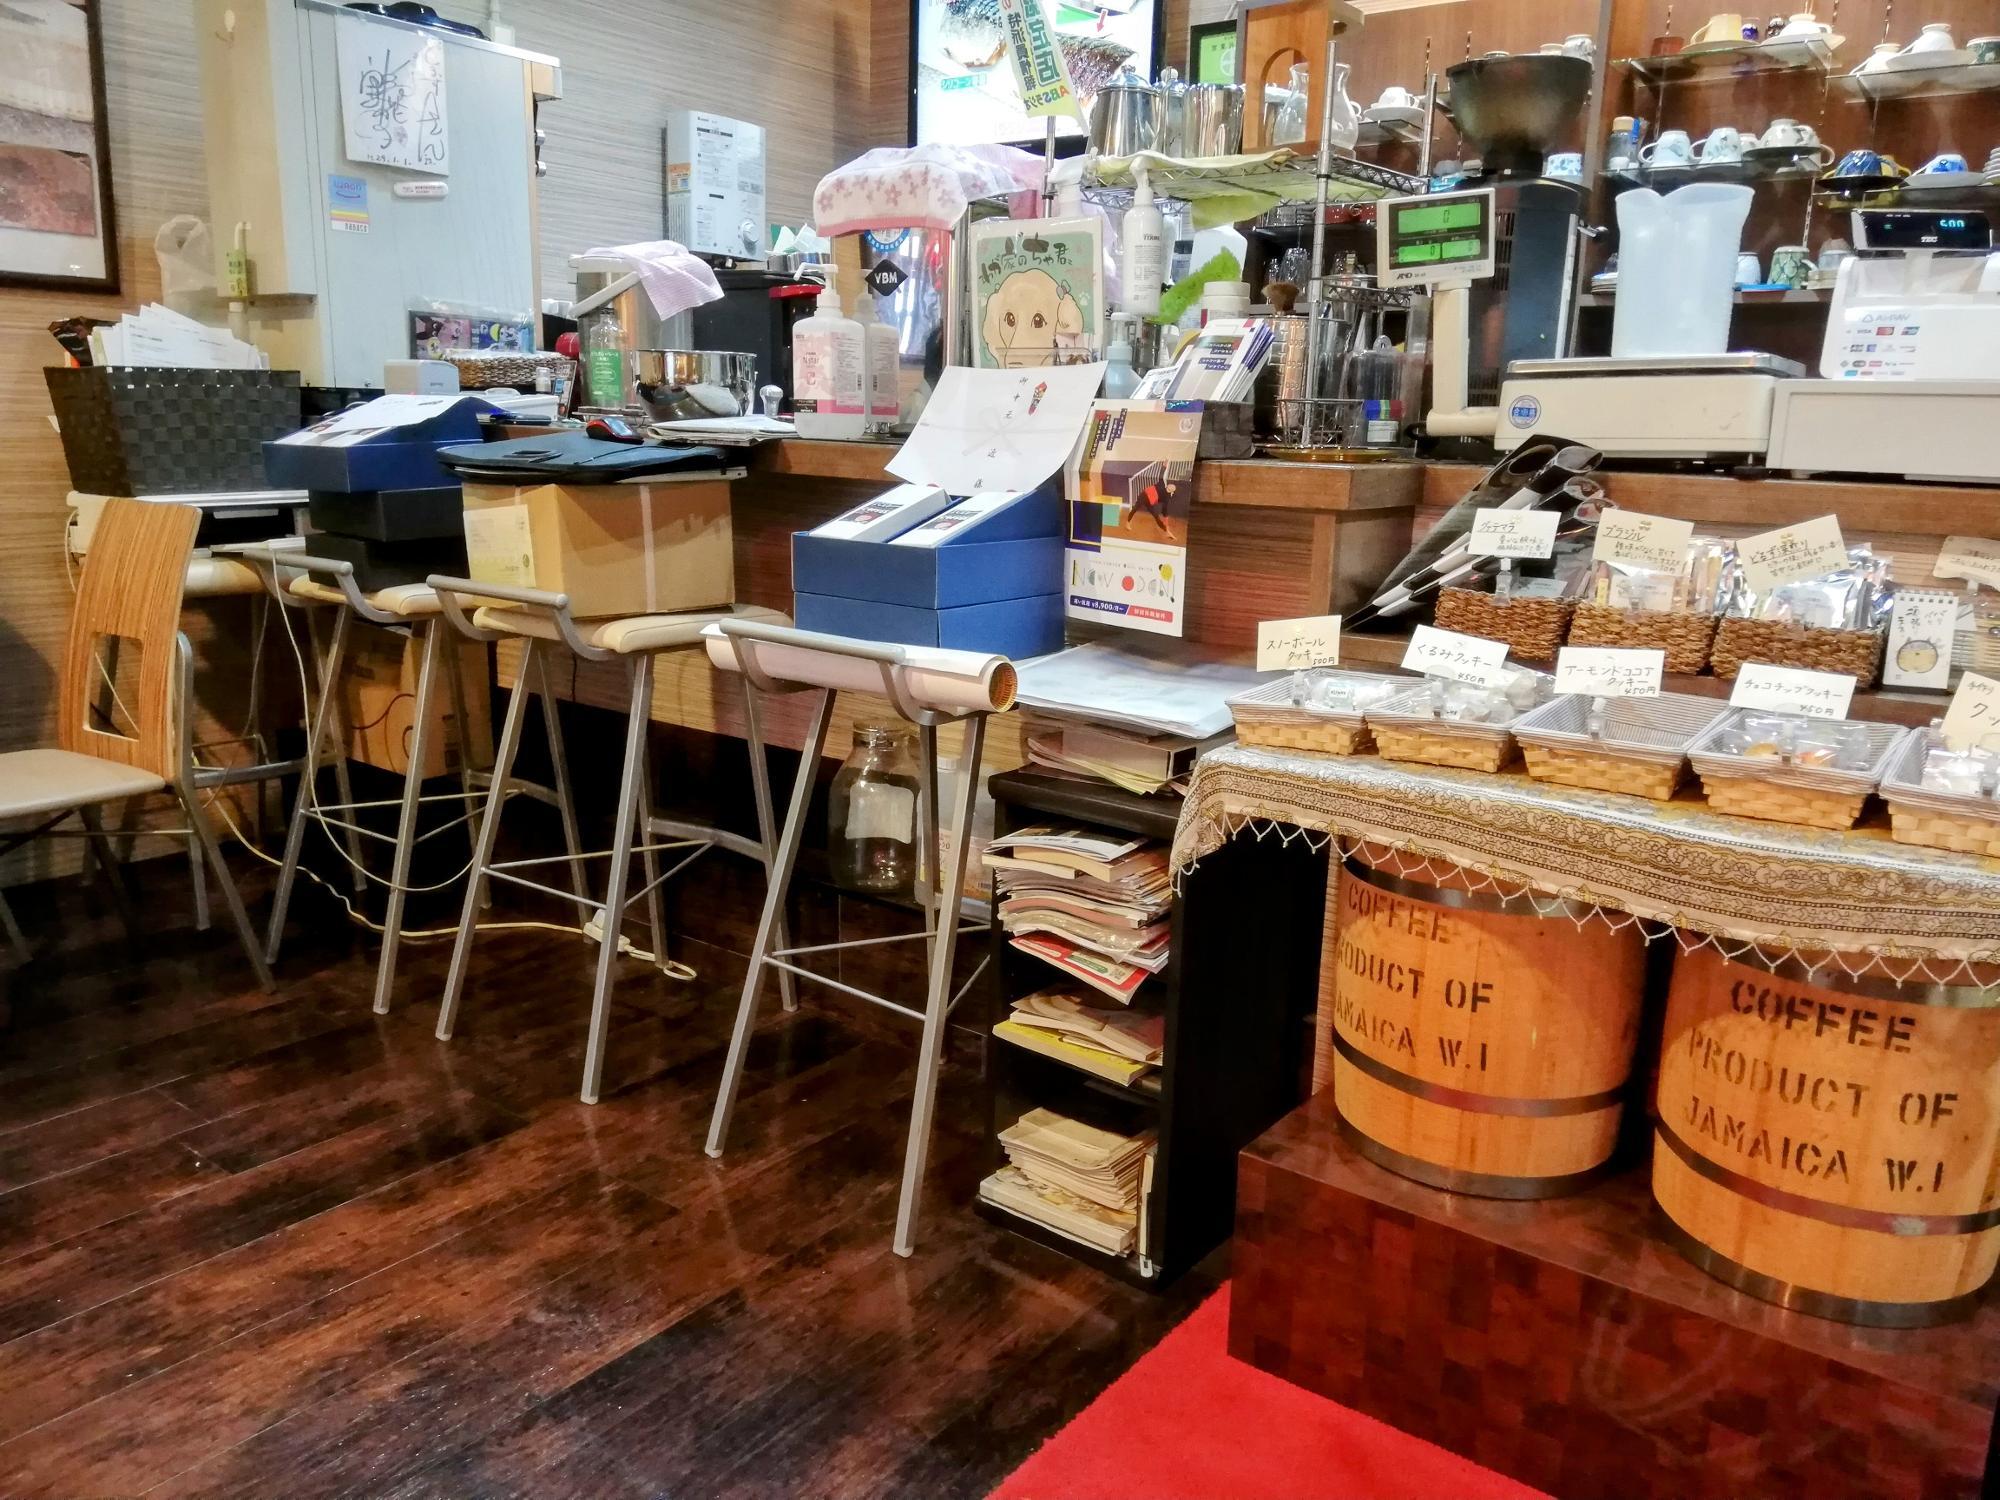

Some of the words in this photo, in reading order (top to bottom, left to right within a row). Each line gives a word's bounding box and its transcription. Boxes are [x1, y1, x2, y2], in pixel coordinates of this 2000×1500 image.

[874, 271, 898, 285] VBM
[1266, 637, 1326, 650] スノーボール
[1288, 648, 1324, 661] クッキー
[1417, 644, 1492, 667] くるみクッキー
[1606, 677, 1649, 688] クッキー
[1744, 678, 1844, 700] チョコチップクッキー
[1348, 882, 1451, 945] COFFEE
[1336, 934, 1425, 999] RODUCT
[1444, 978, 1494, 1013] OF
[1336, 990, 1417, 1058] AMAICA
[1731, 979, 1916, 1054] COFFEE
[1688, 1027, 1871, 1119] PRODUCT
[1899, 1092, 1959, 1129] OF
[1685, 1095, 1850, 1184] JAMAICA
